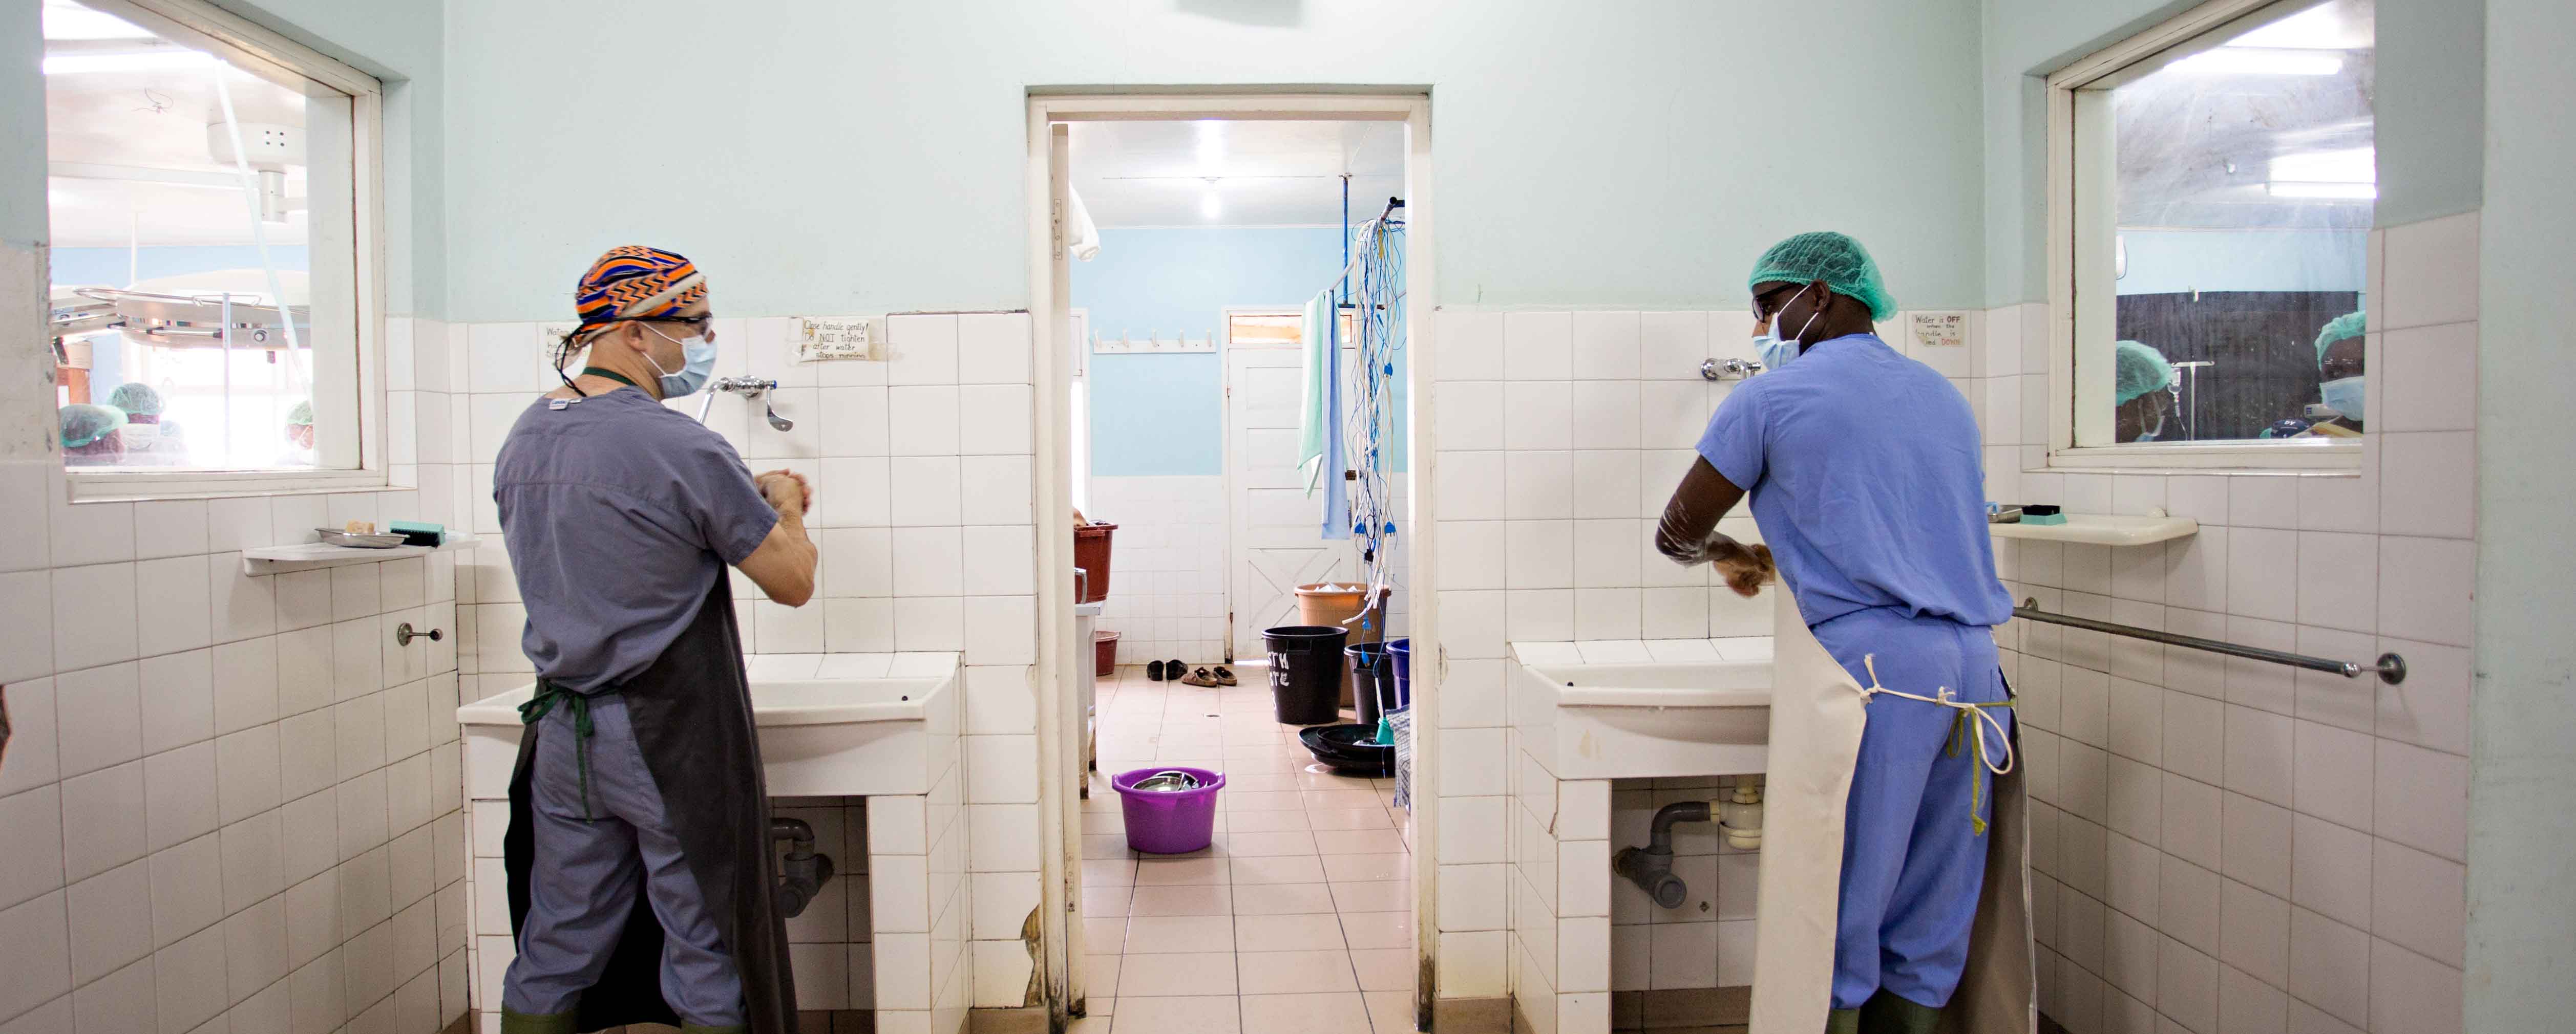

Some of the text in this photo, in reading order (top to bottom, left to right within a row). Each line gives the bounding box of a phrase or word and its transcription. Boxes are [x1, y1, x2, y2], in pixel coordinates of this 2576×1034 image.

[805, 320, 869, 334] Close handle gently!
[805, 332, 865, 343] Do NOT tighten
